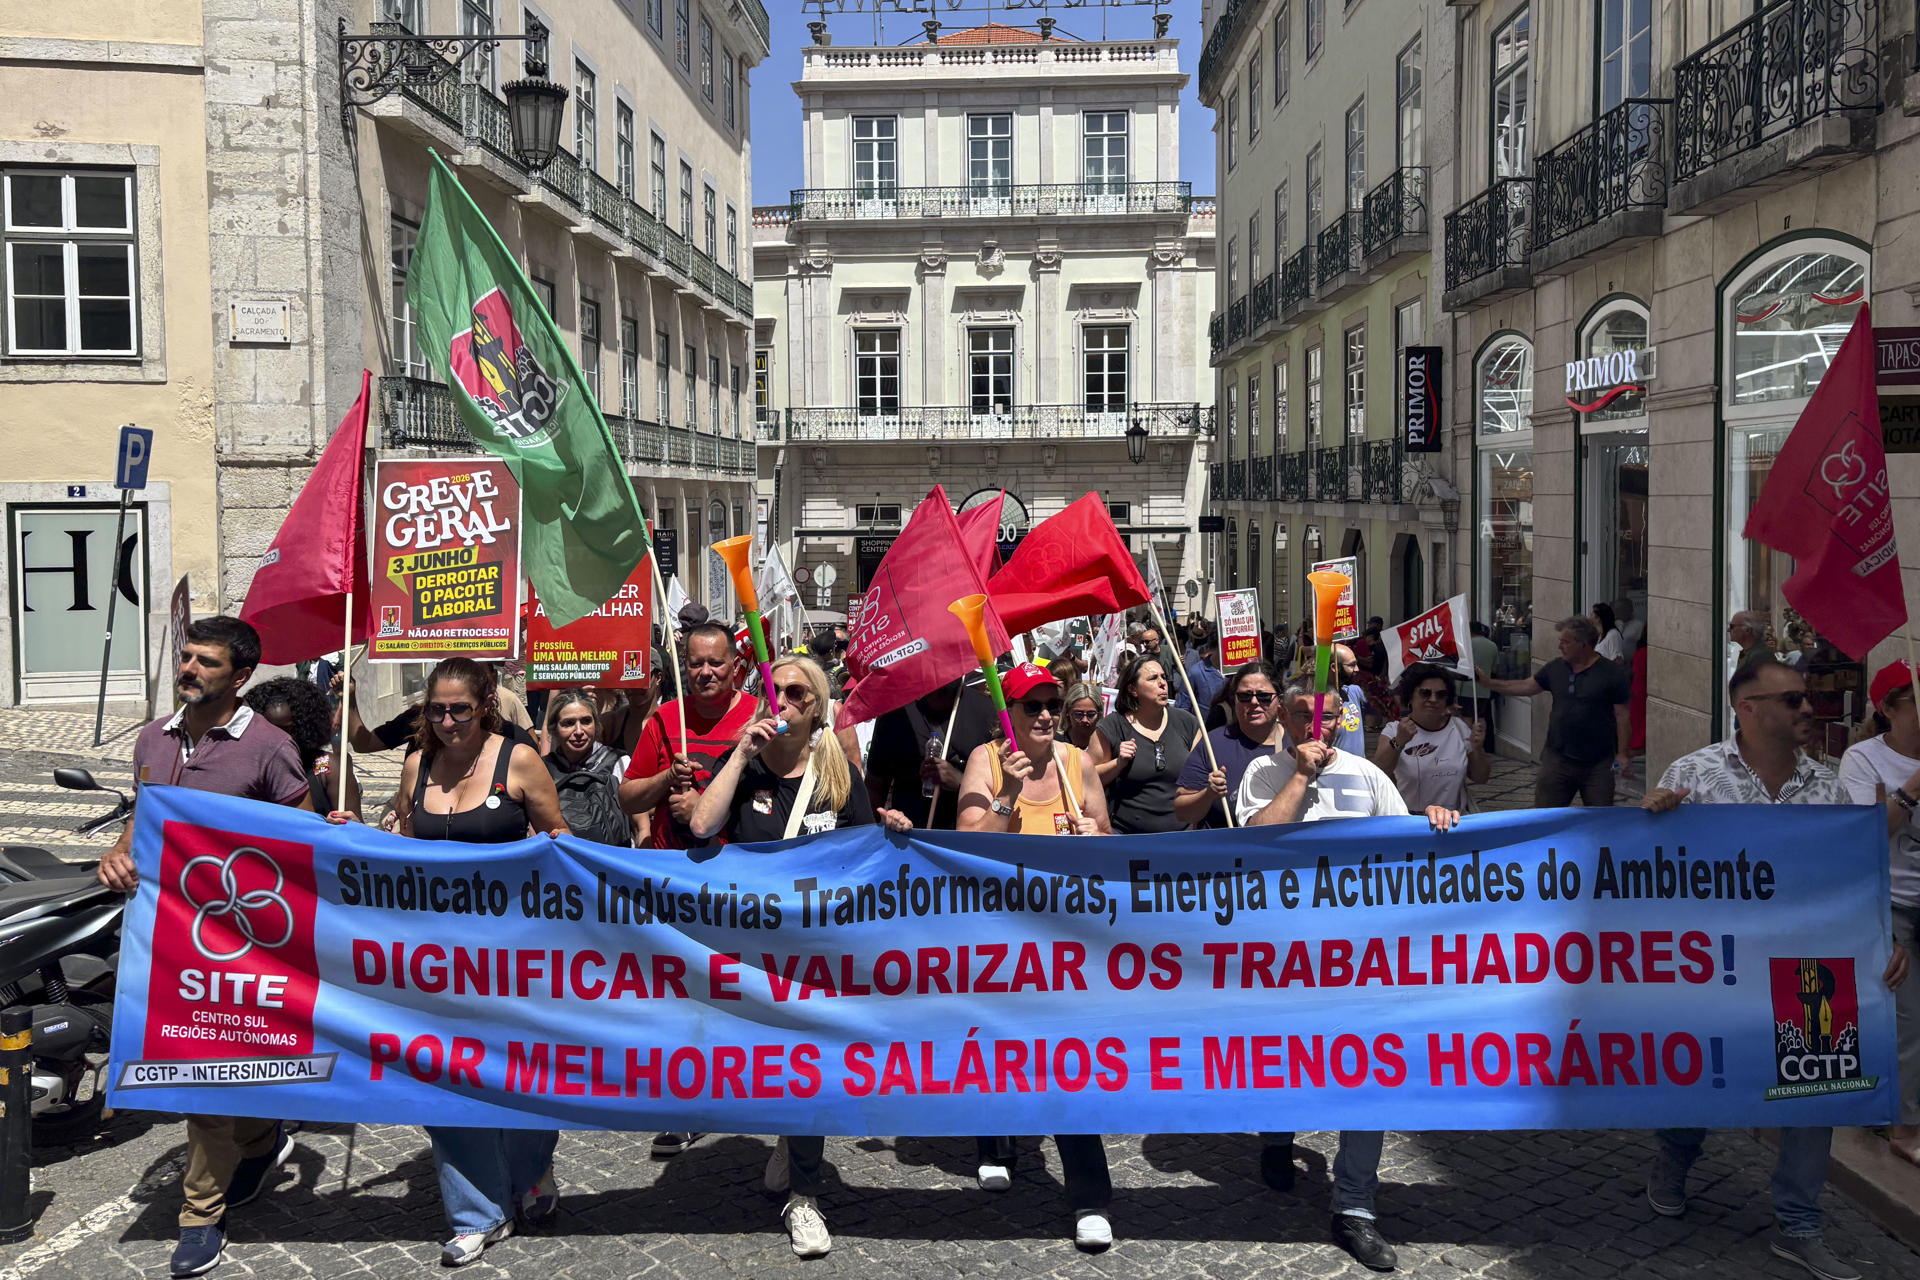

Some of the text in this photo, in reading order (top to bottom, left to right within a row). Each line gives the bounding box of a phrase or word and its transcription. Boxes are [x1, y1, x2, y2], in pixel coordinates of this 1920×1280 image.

[241, 307, 277, 316] CALÇADA
[254, 317, 265, 325] DO
[235, 327, 285, 336] SACRAMENTO
[1878, 342, 1920, 370] TAPAS
[1565, 349, 1638, 393] PRIMOR
[1407, 353, 1427, 445] PRIMOR
[124, 433, 146, 483] P
[451, 474, 470, 484] 2026
[73, 486, 81, 497] 2
[383, 470, 499, 514] GREVE
[385, 500, 511, 549] GERAL
[392, 549, 473, 574] 3 JUNHO
[416, 566, 499, 590] DERROTAR
[420, 582, 494, 604] O PACOTE
[422, 597, 496, 619] LABORAL
[408, 627, 509, 637] NÃO AO RETROCESSO!
[1224, 616, 1254, 627] SÓ MAIS UM
[1410, 614, 1443, 644] STAL
[385, 640, 506, 650] SALÁRIO DIREITOS SERVIÇOS PÚBLICOS
[534, 640, 575, 650] É POSSÍVEL
[1227, 638, 1255, 651] E O PACOTE
[533, 651, 618, 661] UMA VIDA MELHOR
[533, 662, 610, 672] MAIS SALÁRIO, DIREITOS
[533, 670, 601, 681] E SERVIÇOS PÚBLICOS
[336, 846, 1776, 930] Sindicato das Indústrias Transformadoras, Energia e Actividades do Ambiente
[352, 930, 1737, 1003] DIGNIFICAR E VALORIZAR OS TRABALHADORES!
[178, 968, 290, 1010] SITE
[192, 1010, 268, 1029] CENTRO SUL
[161, 1023, 297, 1047] REGIÕES AUTÓNOMAS
[369, 1019, 1726, 1100] POR MELHORES SALÁRIOS E MENOS HORÁRIO!
[1780, 1053, 1858, 1081] CGTP
[135, 1064, 179, 1083] CGTP
[192, 1060, 319, 1082] INTERSINDICAL
[1768, 1079, 1871, 1097] INTERSINDICAL NACIONAL
